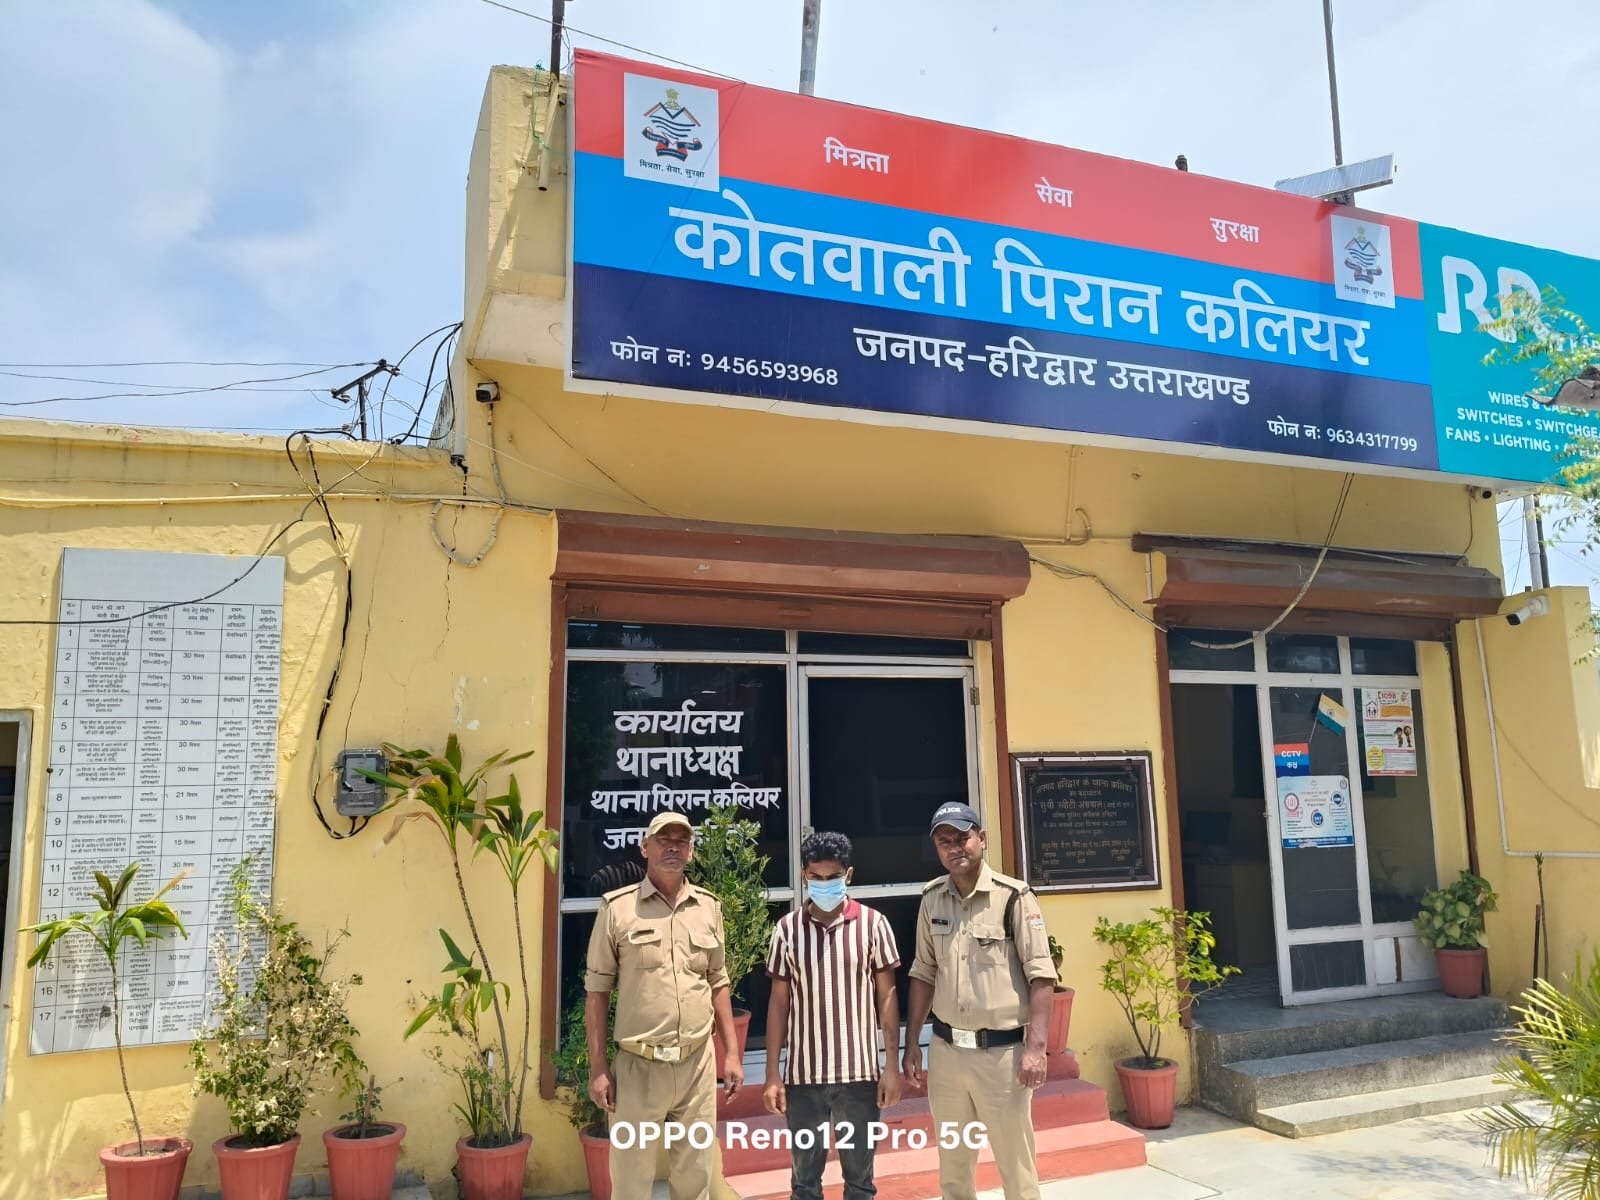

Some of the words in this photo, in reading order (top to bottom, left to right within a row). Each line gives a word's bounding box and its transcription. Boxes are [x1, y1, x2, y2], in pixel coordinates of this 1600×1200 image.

[824, 136, 890, 175] मित्रता
[1034, 177, 1073, 208] सेवा
[1210, 217, 1260, 244] सुरक्षा
[668, 188, 971, 308] कोतवाली
[993, 238, 1162, 335] पिरान
[1181, 278, 1370, 366] कलियर
[610, 335, 659, 365] फोन
[701, 353, 839, 386] 9456593968
[1107, 360, 1250, 405] उत्तराखण्ड
[1488, 390, 1528, 409] WIRES
[1457, 407, 1523, 428] SWITCHES
[1267, 415, 1299, 440] फोन
[1326, 427, 1418, 453] 9634317799
[1446, 426, 1481, 444] FANS
[1535, 418, 1600, 439] SWITCHGE
[1493, 432, 1551, 453] LIGHTING
[65, 653, 72, 661] 2
[63, 676, 70, 684] 3
[60, 722, 67, 730] 5
[613, 699, 744, 735] कार्यालय
[59, 745, 66, 753] 6
[616, 745, 743, 781] थानाध्यक्ष
[56, 793, 62, 801] 8
[590, 789, 650, 814] थाना
[651, 783, 712, 812] पिरान
[712, 782, 781, 809] कलियर
[51, 840, 62, 848] 10
[50, 864, 60, 872] 11
[48, 889, 59, 897] 12
[41, 987, 53, 996] 16
[40, 1012, 51, 1021] 17
